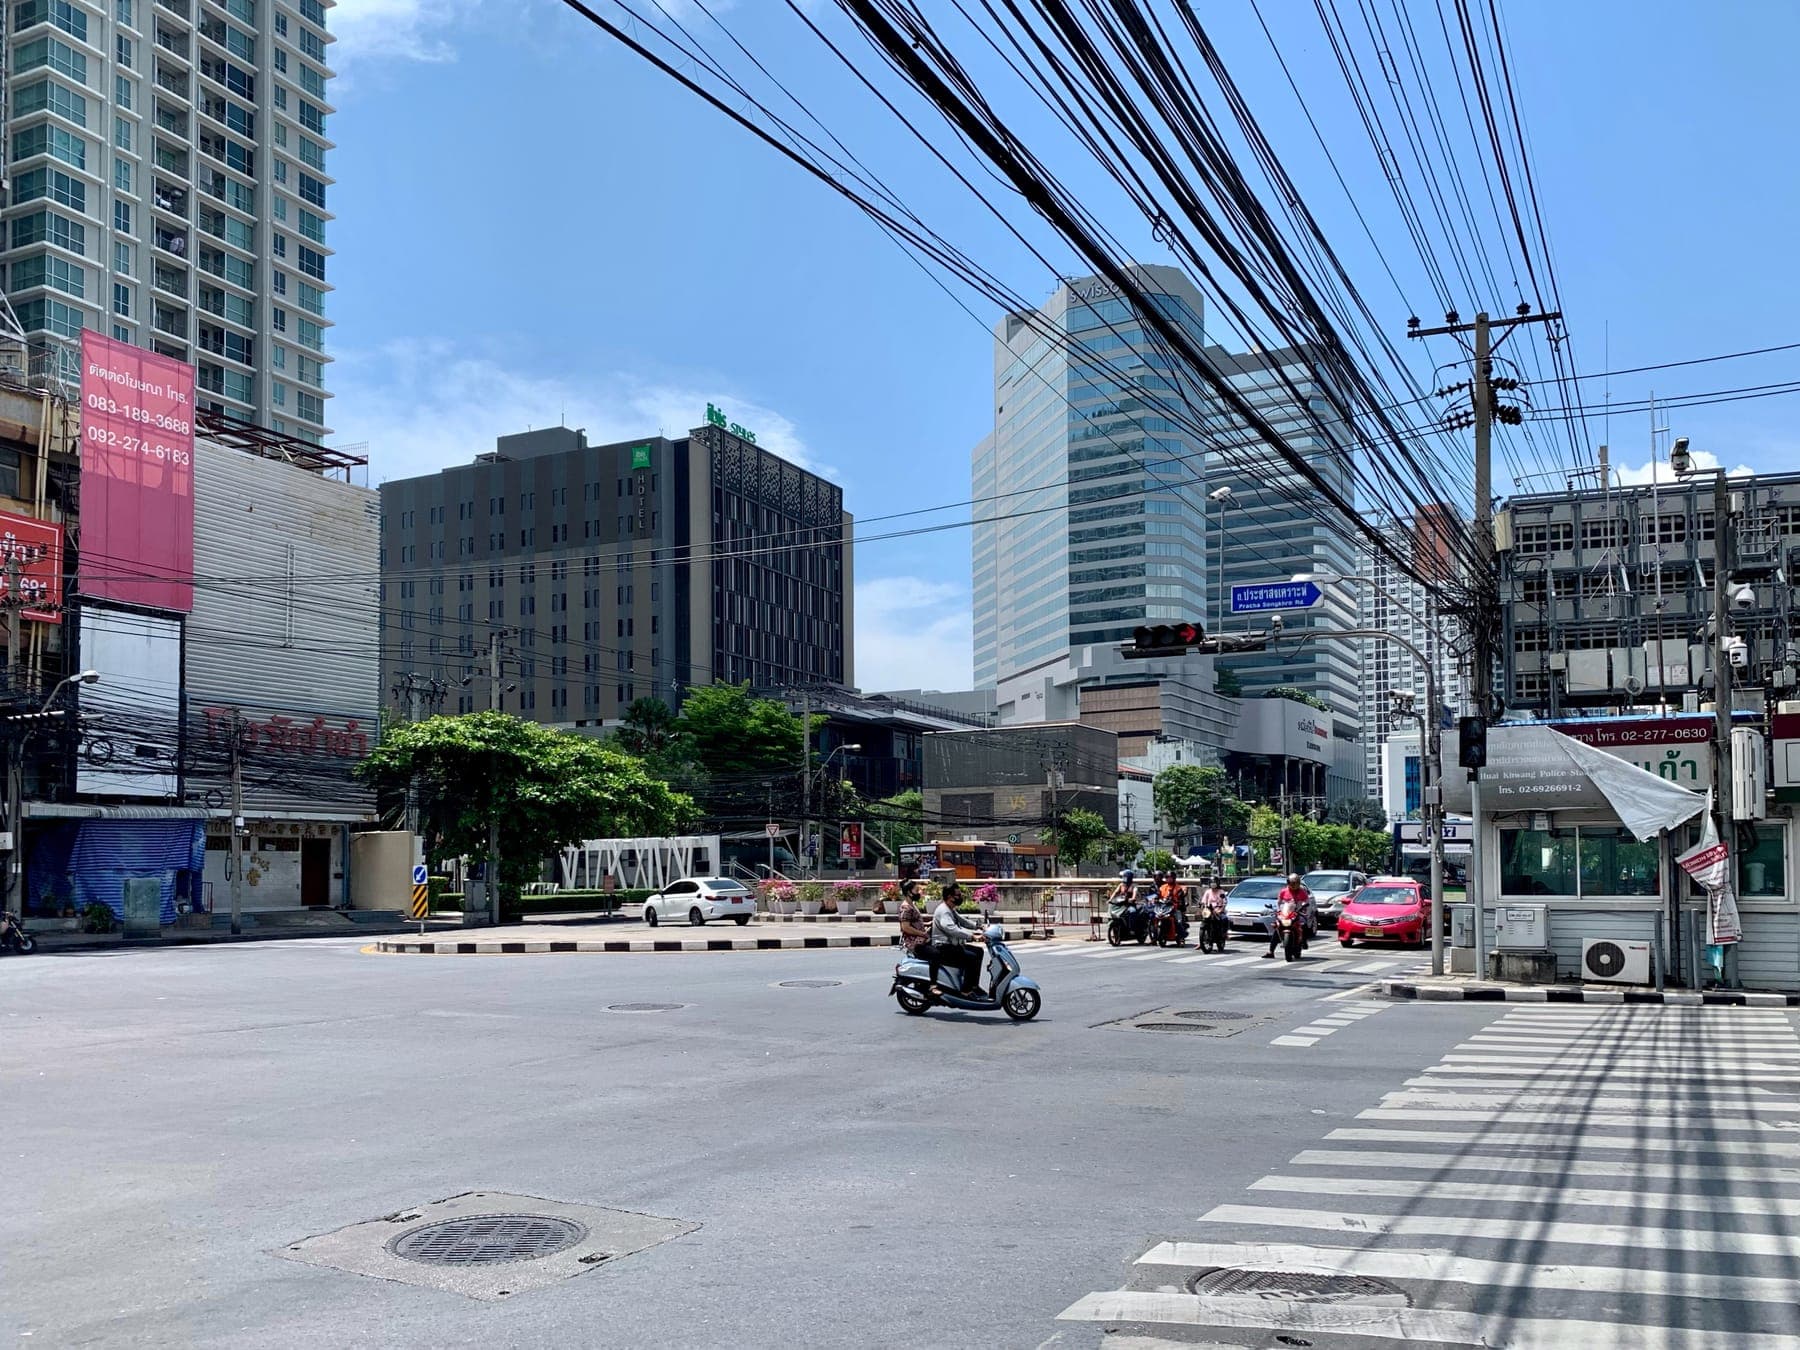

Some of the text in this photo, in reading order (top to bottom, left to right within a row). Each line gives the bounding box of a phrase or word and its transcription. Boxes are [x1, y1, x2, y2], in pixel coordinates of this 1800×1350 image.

[88, 393, 190, 435] 083-189-3688
[706, 402, 727, 429] ibis
[88, 426, 190, 465] 092-274-6183
[637, 474, 647, 529] HOTEL
[1621, 728, 1707, 742] 02-277-0630
[1540, 769, 1566, 778] Police
[1519, 783, 1582, 795] 02-6926691-2
